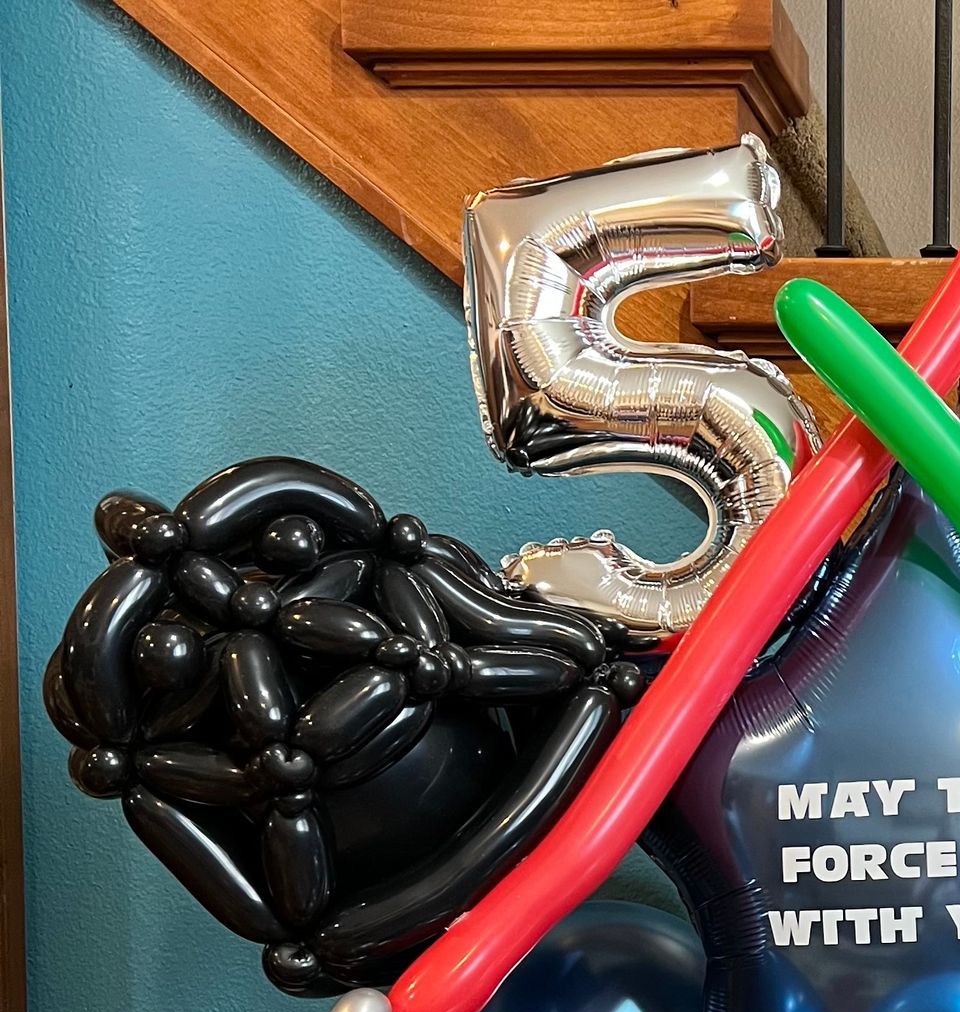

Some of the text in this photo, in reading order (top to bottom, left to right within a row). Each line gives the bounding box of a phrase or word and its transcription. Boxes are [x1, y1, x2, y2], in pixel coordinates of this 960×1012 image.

[777, 779, 916, 820] MAY
[782, 841, 957, 883] FORCE
[767, 906, 923, 946] WITH
